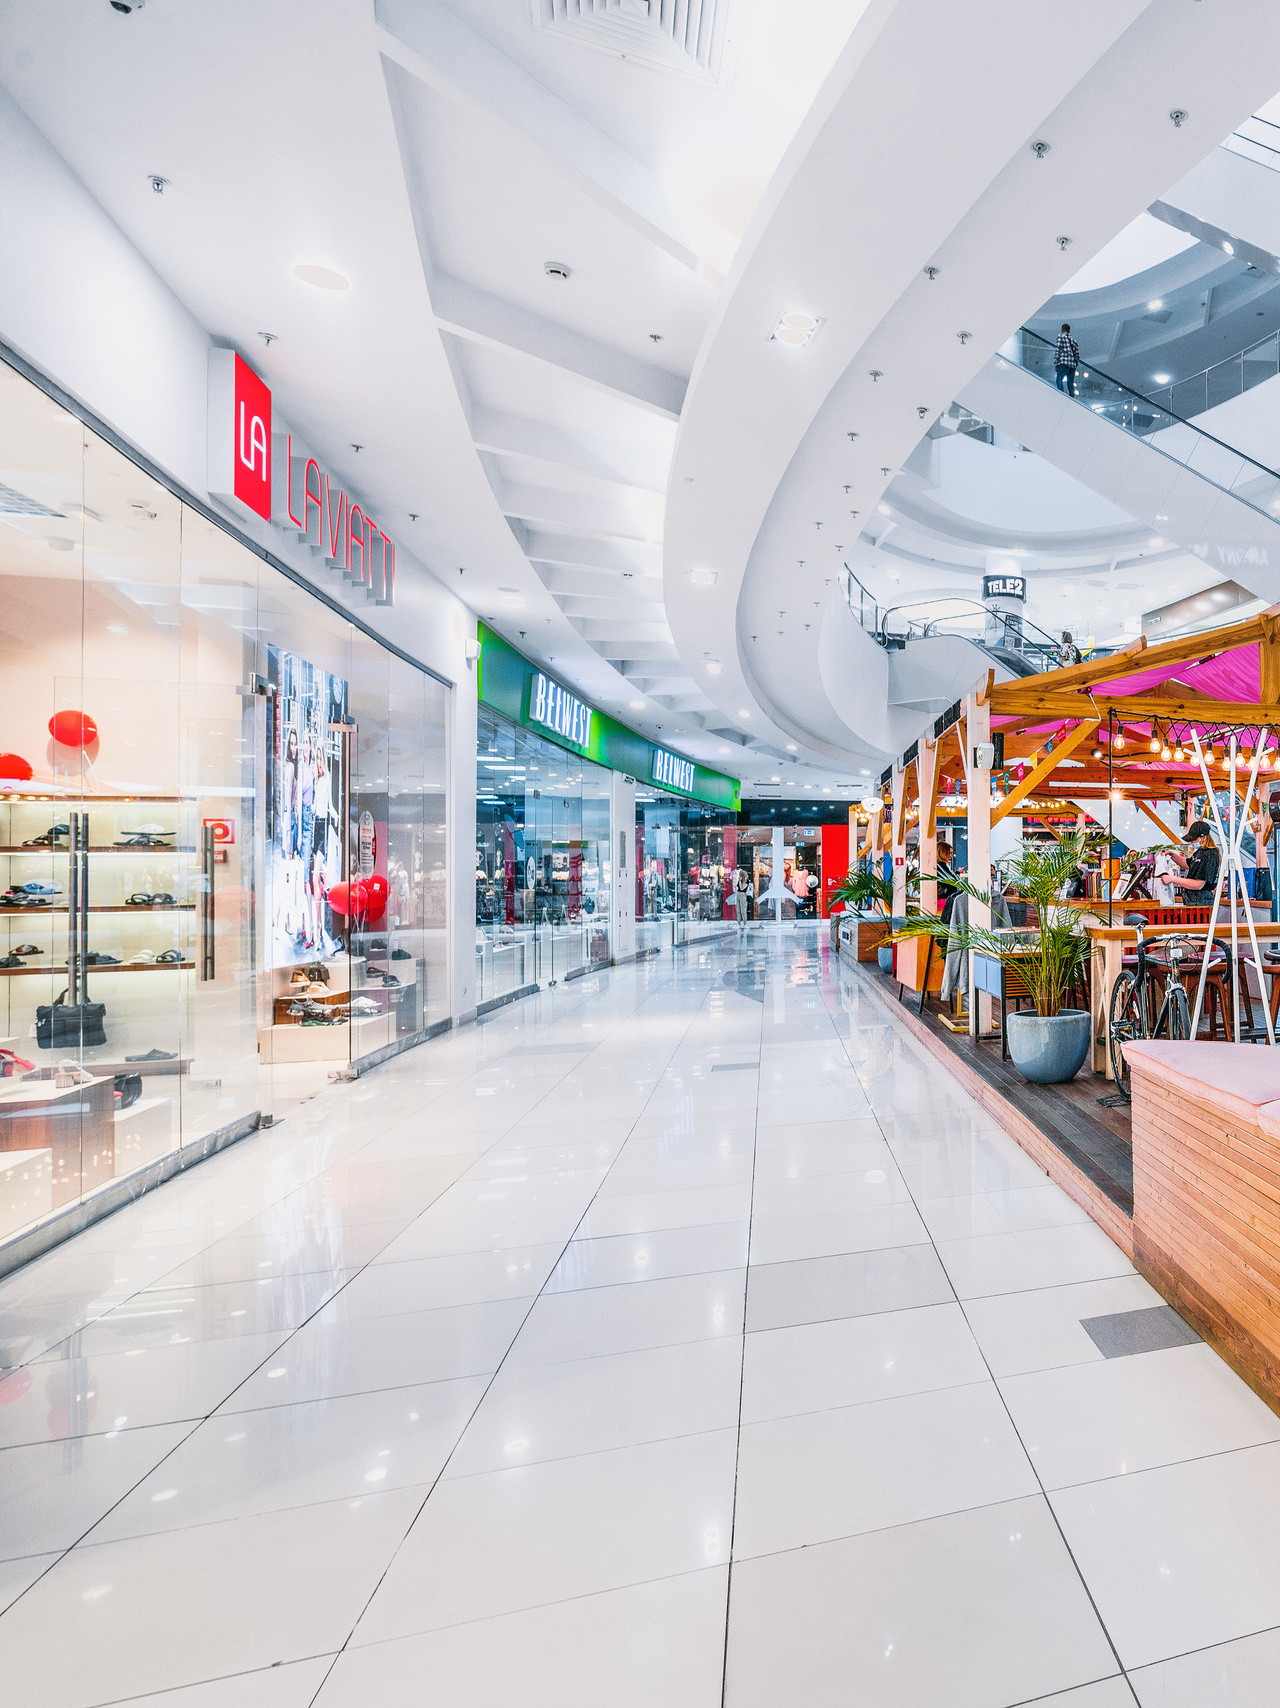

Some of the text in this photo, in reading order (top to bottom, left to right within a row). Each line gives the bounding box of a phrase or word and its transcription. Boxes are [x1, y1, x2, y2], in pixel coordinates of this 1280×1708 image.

[241, 401, 396, 607] LA LAVIATTI
[987, 578, 1023, 596] TELE2
[536, 673, 593, 748] BELWEST
[655, 749, 696, 792] BELWEST
